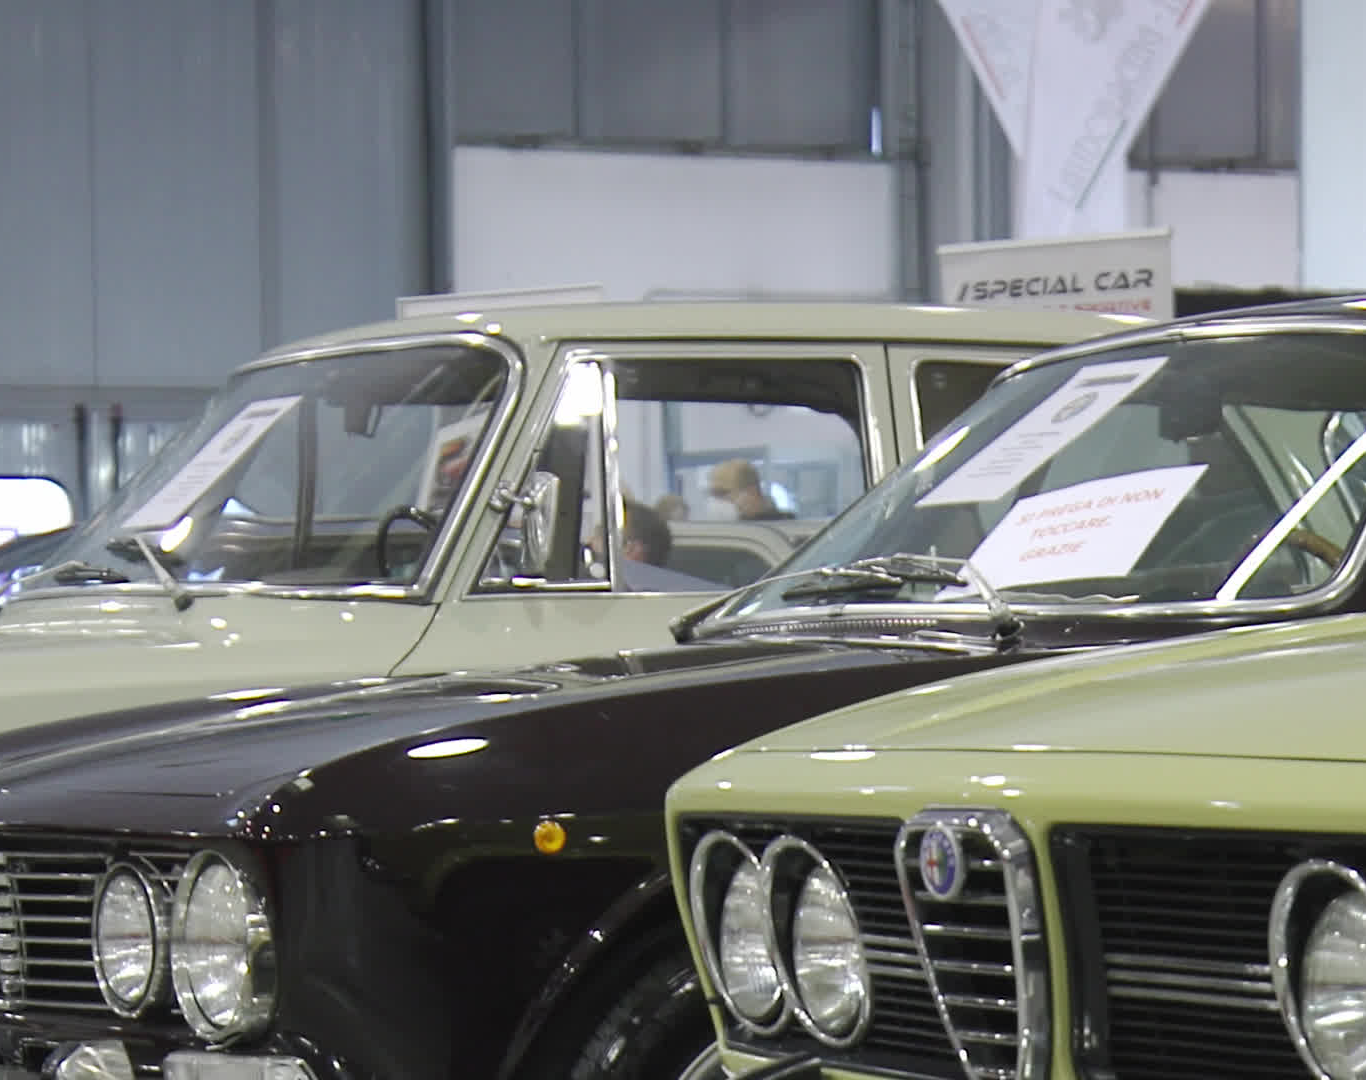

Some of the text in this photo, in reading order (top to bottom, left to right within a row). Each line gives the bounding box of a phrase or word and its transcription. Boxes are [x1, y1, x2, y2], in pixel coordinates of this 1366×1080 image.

[972, 268, 1154, 301] SPECIAL CAR
[1038, 499, 1094, 518] PREGA
[1096, 495, 1117, 508] DI
[1121, 488, 1165, 504] NON
